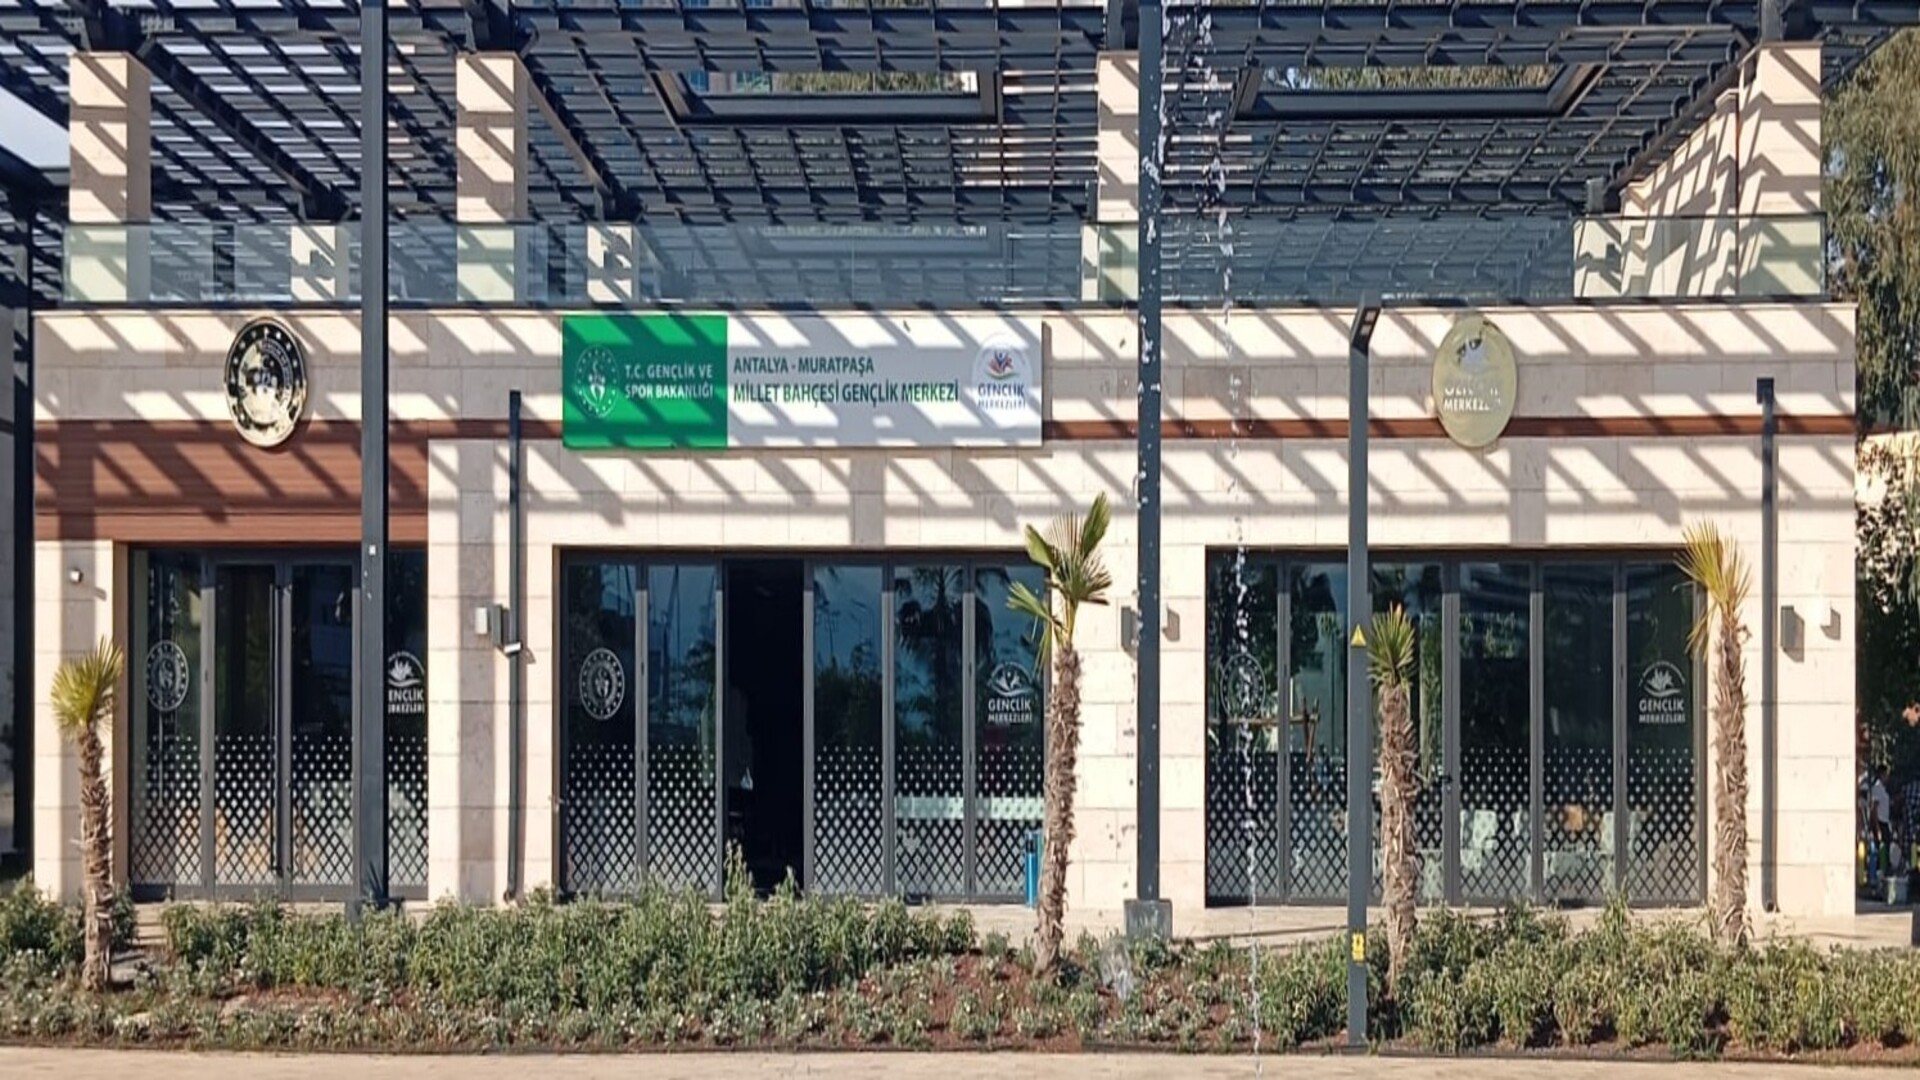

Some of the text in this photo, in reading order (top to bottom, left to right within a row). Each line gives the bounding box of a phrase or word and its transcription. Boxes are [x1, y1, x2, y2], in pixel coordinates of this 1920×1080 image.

[625, 361, 713, 380] T.C. GENÇLİK VE
[733, 356, 788, 373] ANTALYA
[798, 356, 874, 377] MURATPAŞA
[625, 381, 714, 399] SPOR BAKANLIĞI
[733, 379, 959, 408] MİLLET BAHÇESİ GENÇLİK MERKEZİ
[388, 688, 424, 702] ENÇLİK
